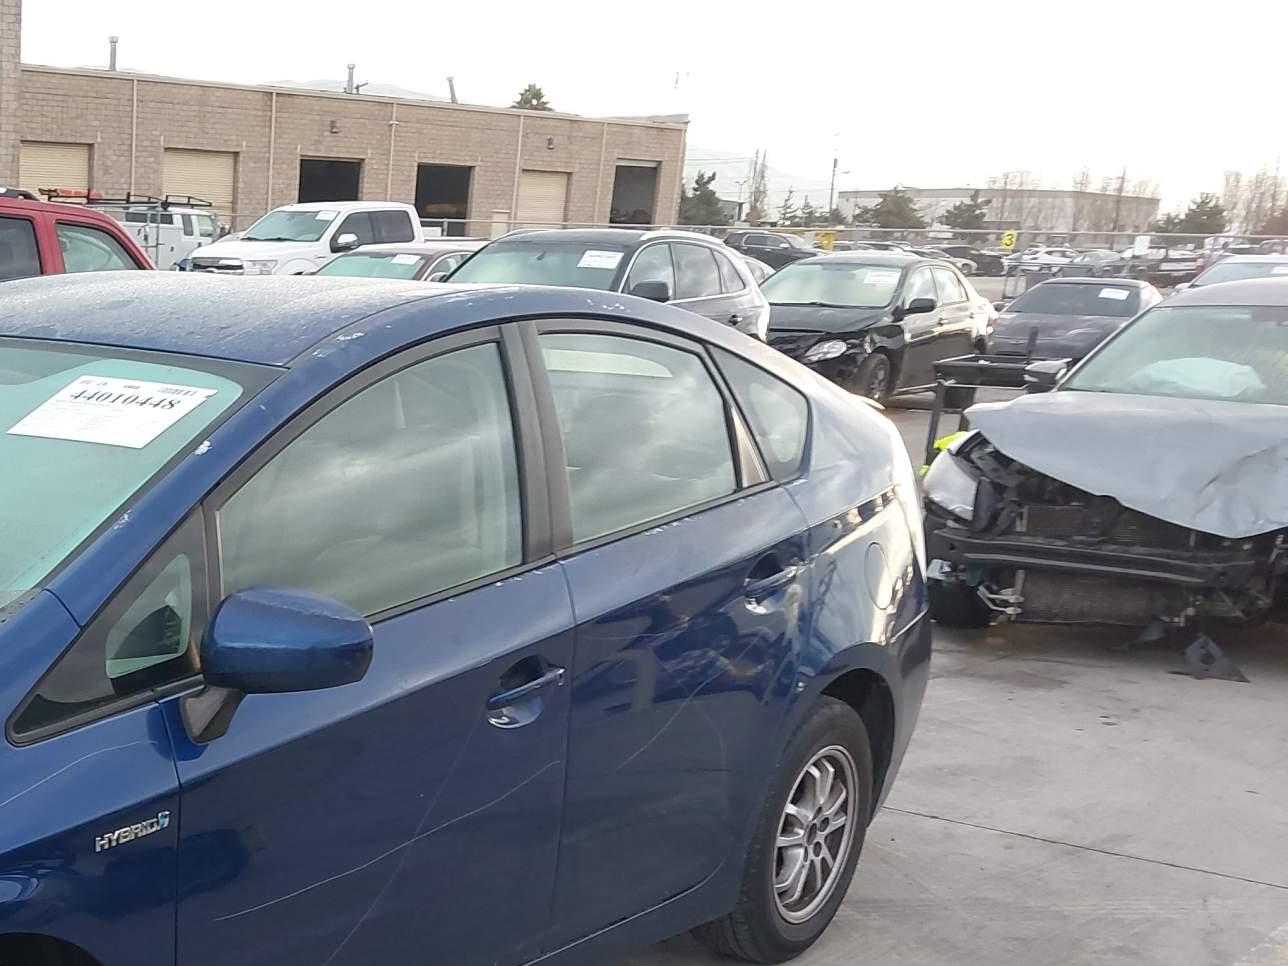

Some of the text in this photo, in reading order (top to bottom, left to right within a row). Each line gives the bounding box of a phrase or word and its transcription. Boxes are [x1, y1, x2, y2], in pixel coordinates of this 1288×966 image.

[1005, 234, 1014, 246] 3
[70, 389, 180, 410] 44010448
[95, 816, 160, 852] HYBRID
